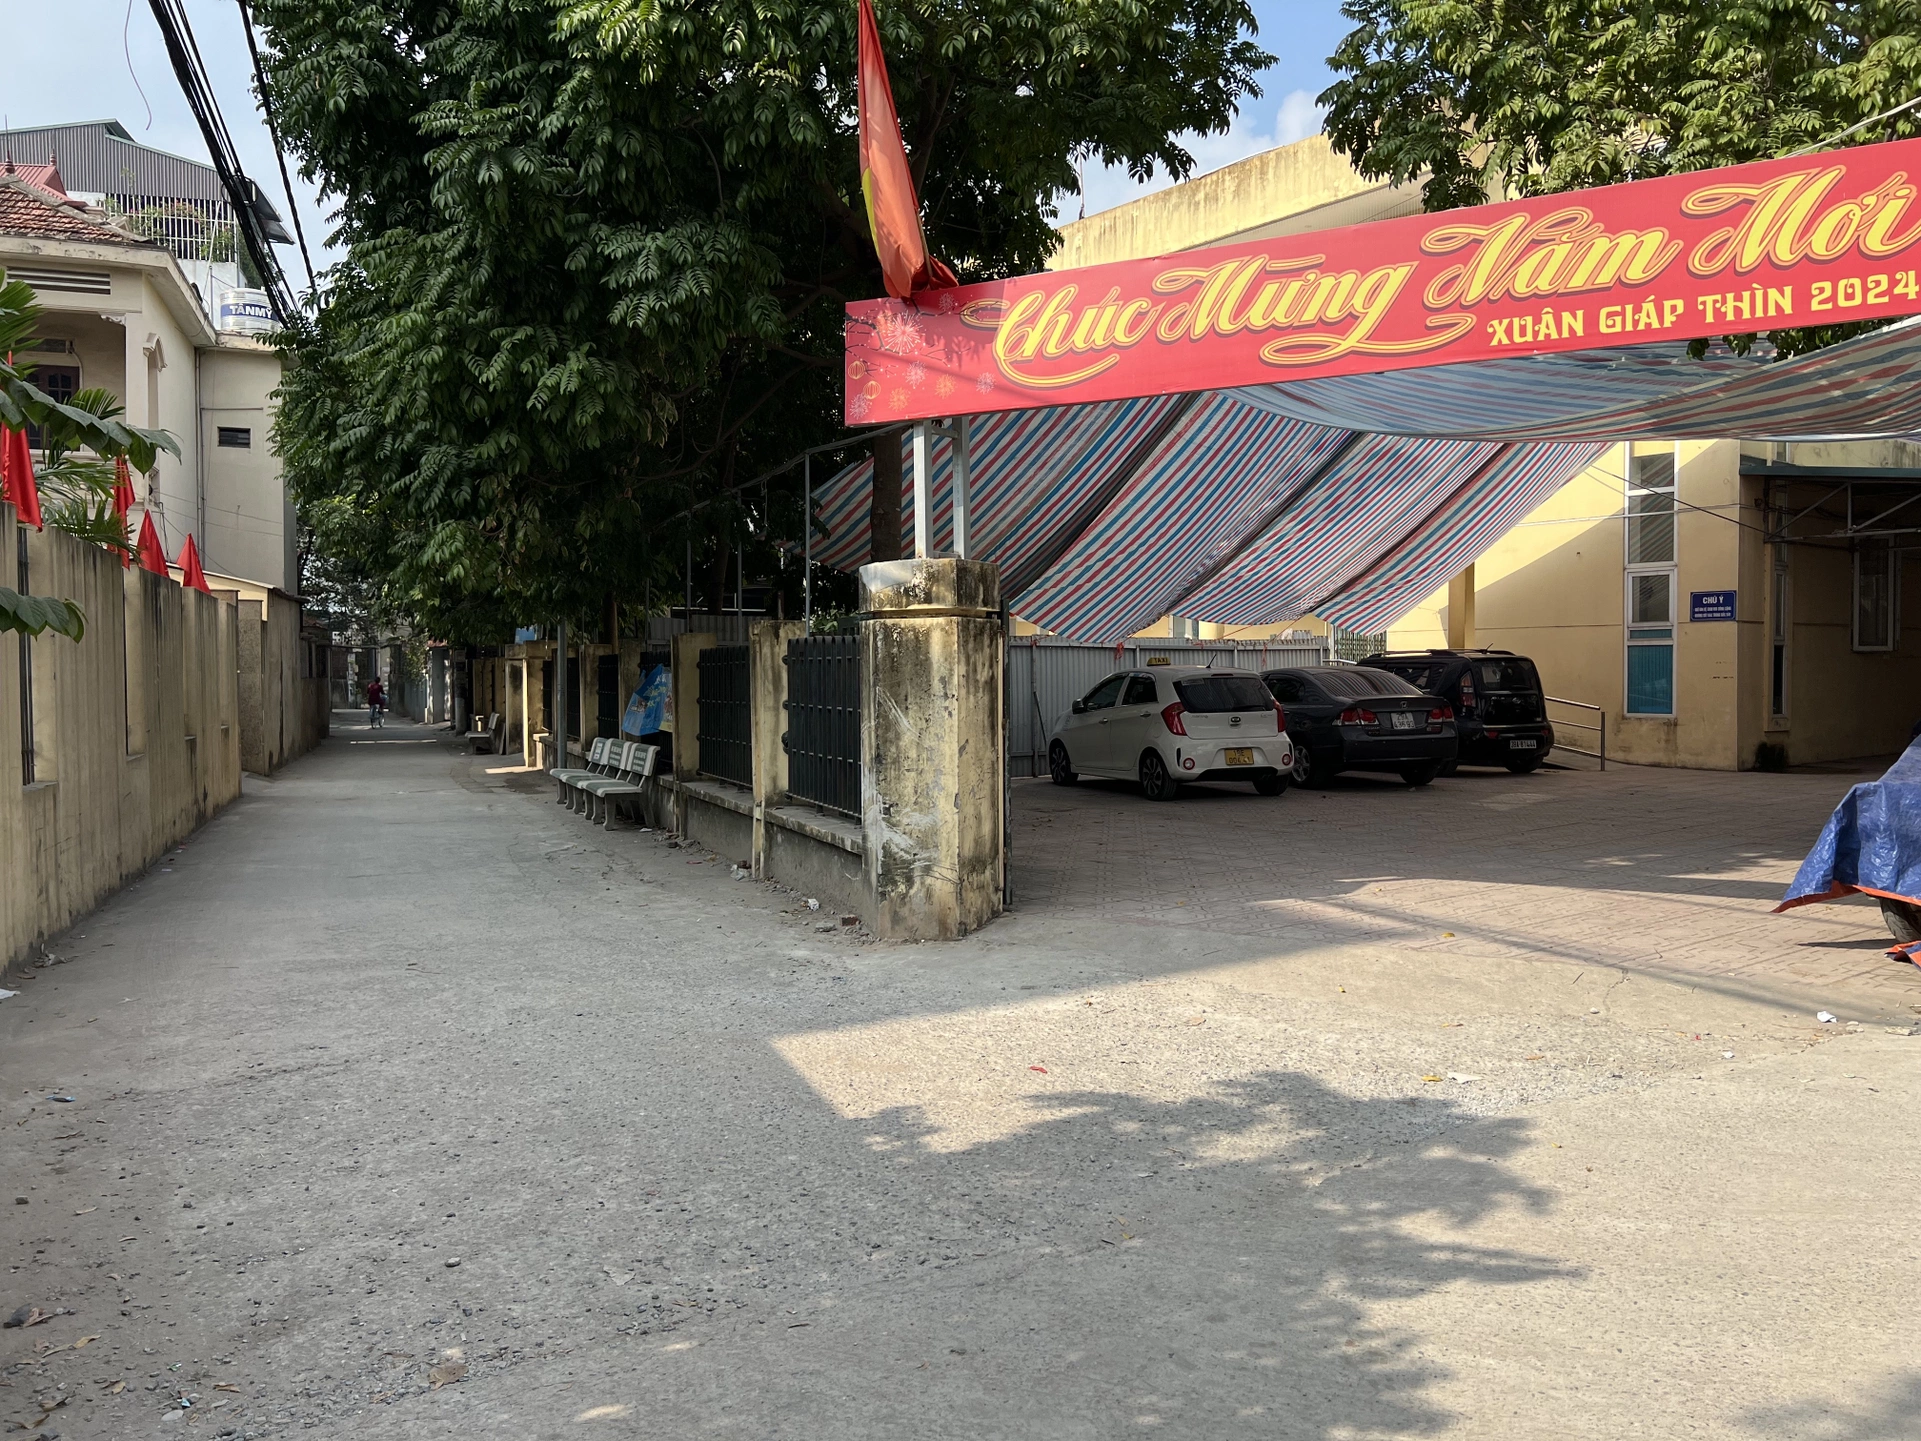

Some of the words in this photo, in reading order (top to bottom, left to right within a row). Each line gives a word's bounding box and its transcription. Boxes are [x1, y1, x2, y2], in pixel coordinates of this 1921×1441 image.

[960, 283, 1166, 388] Chúc
[1152, 253, 1477, 367] Mừng
[1420, 205, 1684, 309] Năm
[1681, 164, 1921, 275] Mới
[1486, 310, 1597, 347] XUÂN
[1598, 295, 1685, 335] GIÁP
[1697, 281, 1794, 324] THÌN
[1810, 270, 1920, 312] 2024
[1702, 595, 1717, 604] CHÚ
